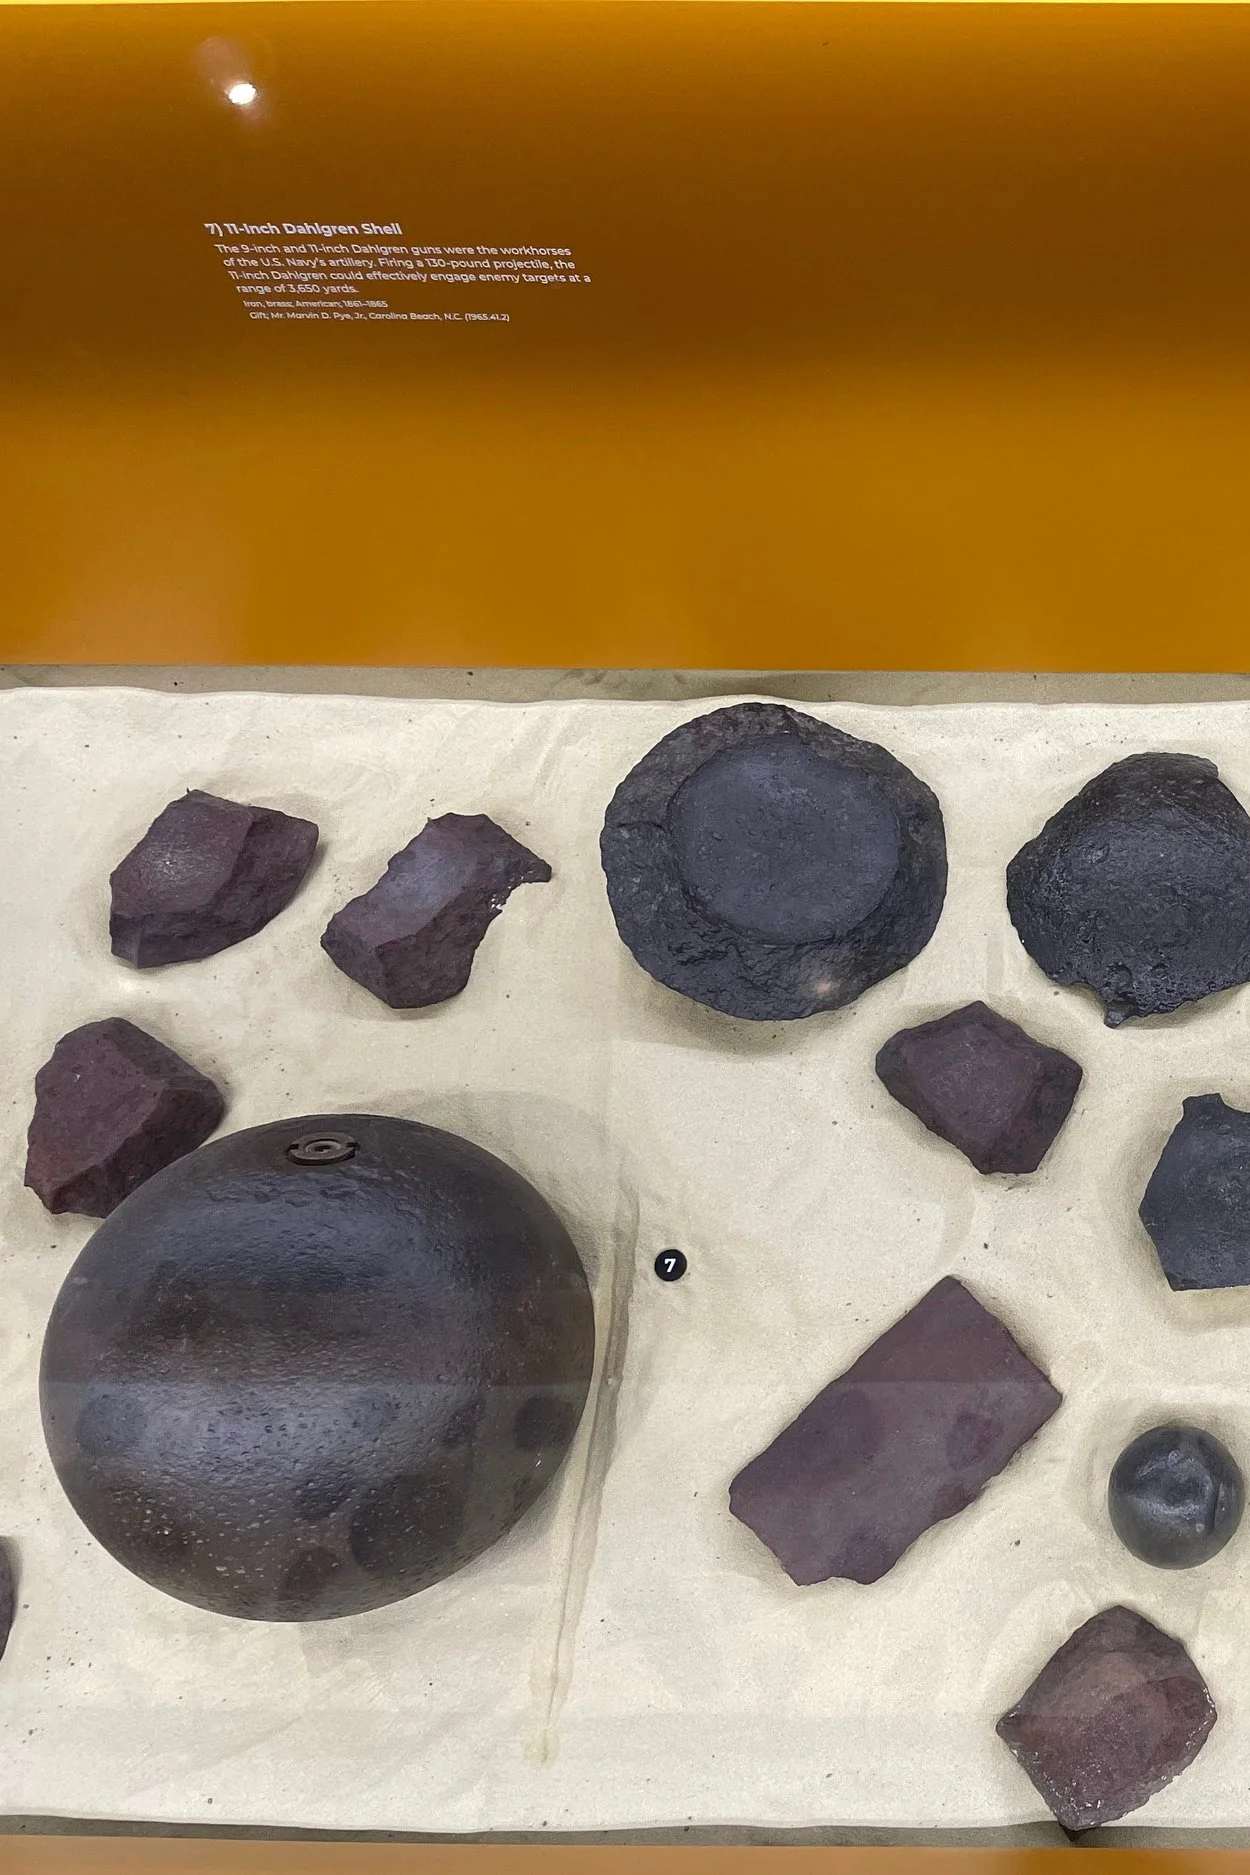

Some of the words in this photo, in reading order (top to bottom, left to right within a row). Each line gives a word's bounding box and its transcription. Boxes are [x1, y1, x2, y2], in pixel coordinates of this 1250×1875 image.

[204, 223, 223, 236] 7)
[223, 223, 280, 234] 11-Inch
[282, 223, 359, 236] Dahlgren
[361, 223, 402, 234] Shell
[214, 244, 240, 253] The
[241, 244, 280, 253] 9-inch
[283, 244, 307, 253] and
[307, 244, 349, 253] 11-inch
[351, 244, 408, 255] Dahlgren
[411, 247, 442, 255] guns
[476, 246, 498, 254] the
[500, 246, 571, 255] workhorses
[224, 258, 234, 266] of
[236, 258, 258, 266] the
[260, 258, 284, 266] U.S.
[328, 258, 376, 268] artillery.
[378, 258, 414, 269] Firing
[424, 258, 490, 269] 130-pound
[493, 259, 552, 270] projectile,
[554, 260, 575, 269] the
[228, 271, 269, 279] 11-inch
[270, 271, 328, 281] Dahlgren
[330, 271, 364, 280] could
[366, 271, 427, 282] effectively
[430, 274, 476, 282] engage
[479, 274, 519, 283] enemy
[522, 274, 566, 284] targets
[569, 274, 581, 282] at
[236, 286, 271, 294] range
[274, 284, 286, 292] of
[287, 284, 320, 294] 3,650
[322, 284, 358, 294] yards.
[333, 312, 353, 320] Pye,
[355, 312, 367, 320] Jr.,
[465, 314, 509, 322] (1965.41.2)
[665, 1258, 676, 1272] 7
